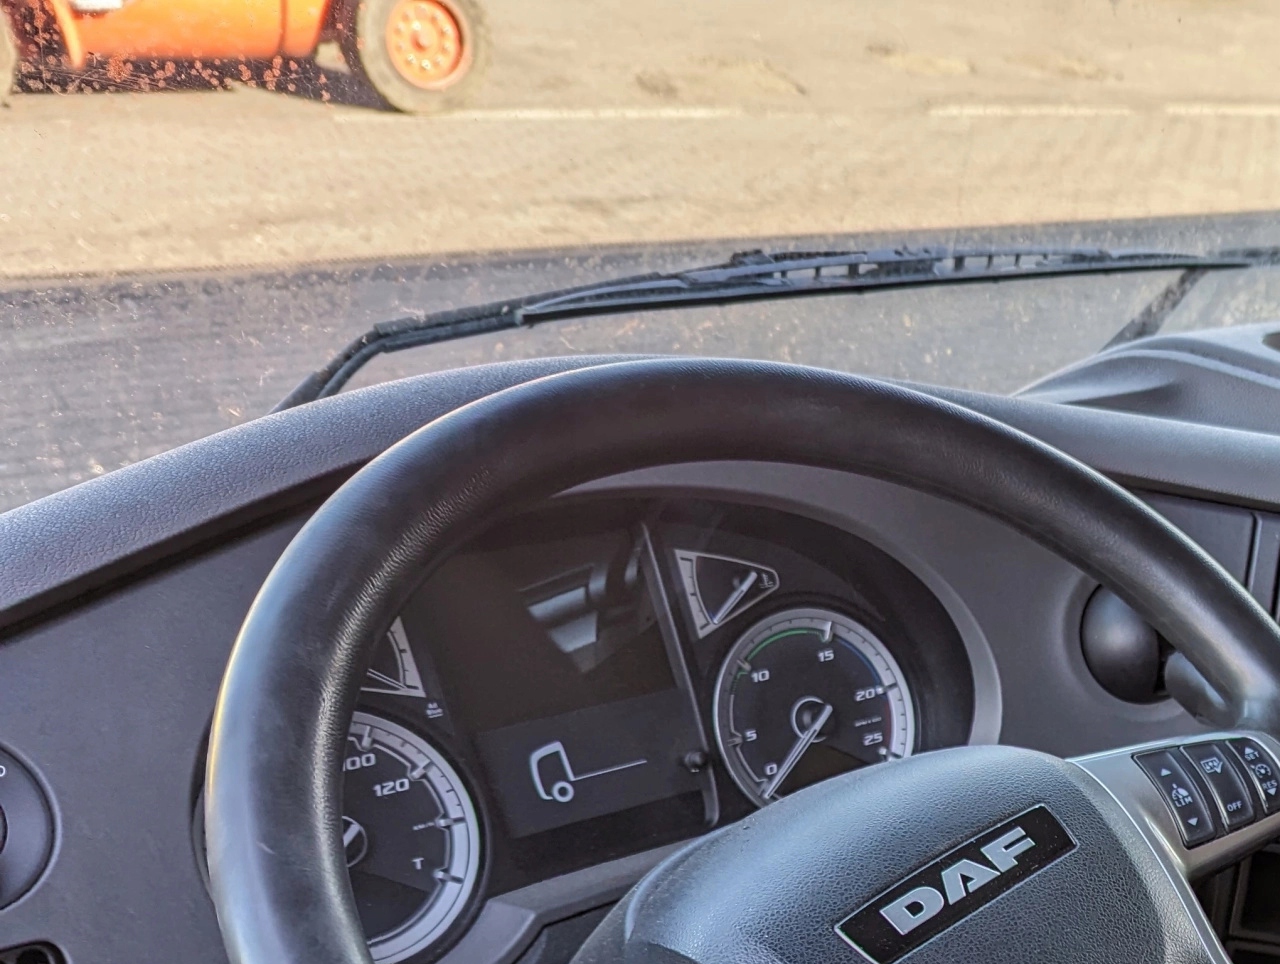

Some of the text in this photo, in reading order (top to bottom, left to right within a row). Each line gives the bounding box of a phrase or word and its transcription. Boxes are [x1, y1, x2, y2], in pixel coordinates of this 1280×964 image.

[818, 650, 834, 662] 15
[751, 670, 770, 682] 10
[855, 689, 875, 701] 20
[745, 730, 757, 741] 5
[863, 733, 883, 746] 25
[1244, 749, 1260, 761] SET
[342, 753, 376, 772] 00
[766, 764, 777, 775] 0
[373, 778, 410, 797] 120
[1262, 780, 1278, 791] RES
[1174, 795, 1193, 808] LIM
[1226, 801, 1242, 811] OFF
[412, 857, 425, 870] T
[878, 826, 1037, 936] DAF
